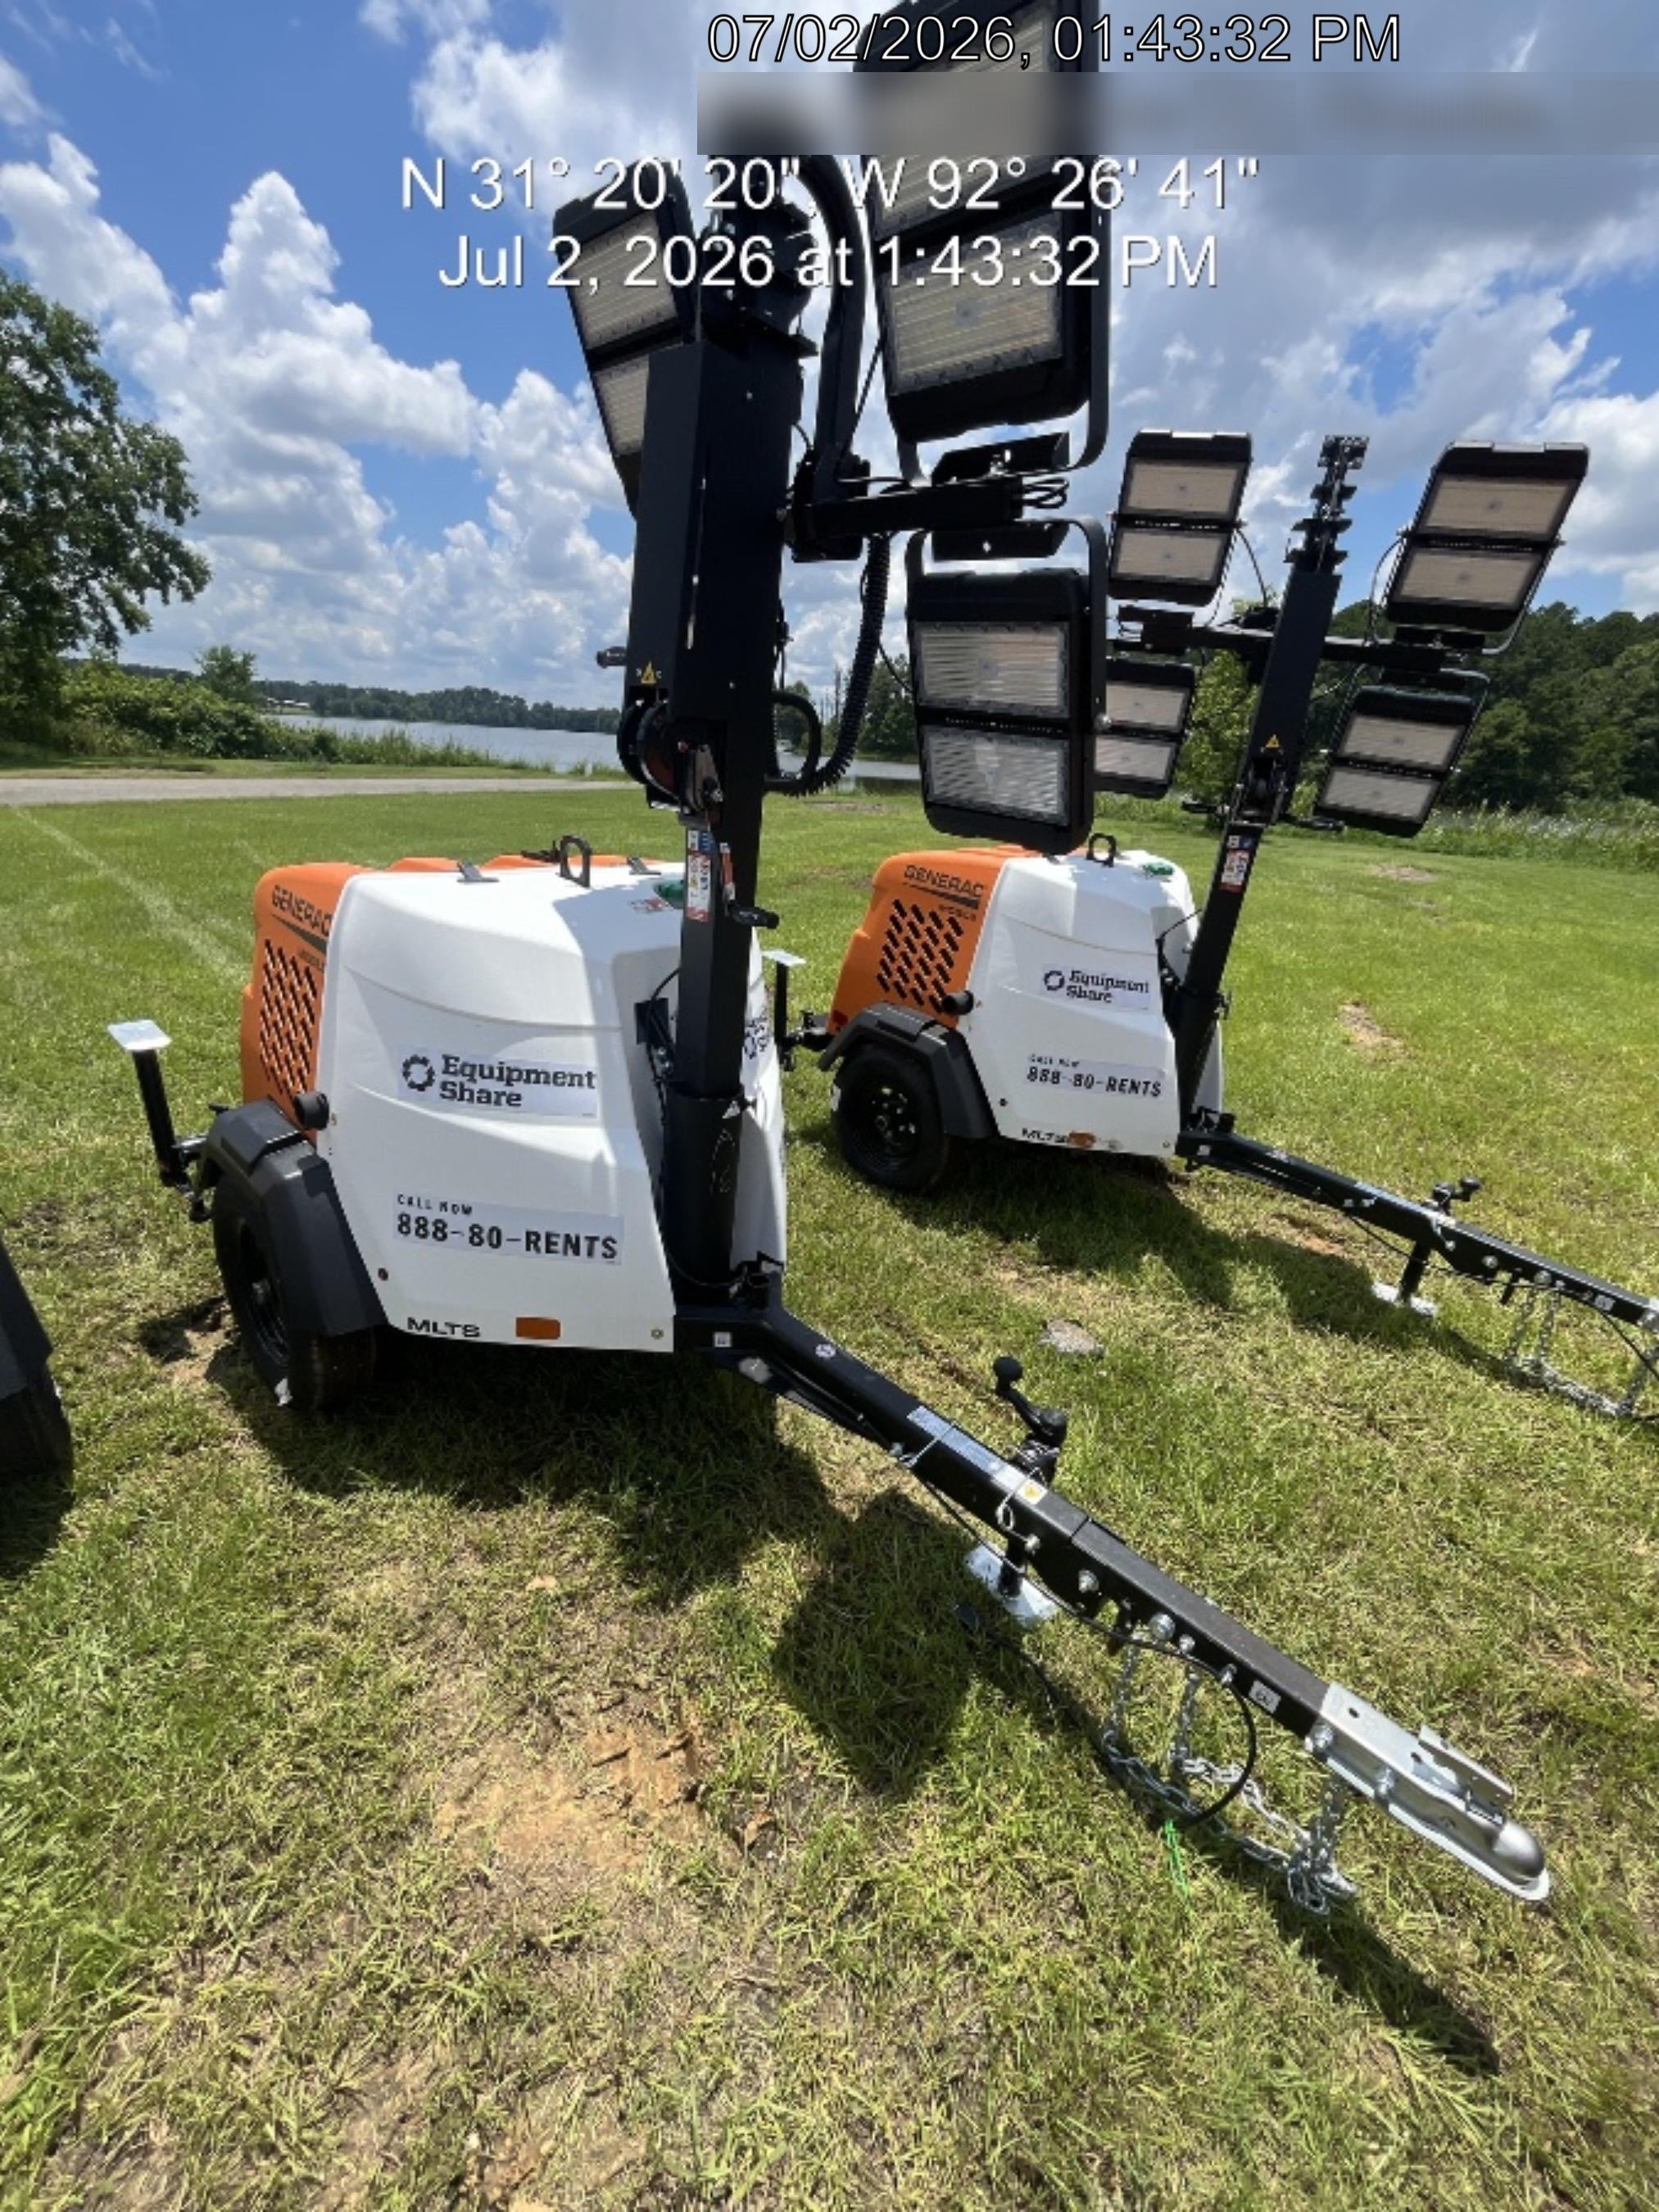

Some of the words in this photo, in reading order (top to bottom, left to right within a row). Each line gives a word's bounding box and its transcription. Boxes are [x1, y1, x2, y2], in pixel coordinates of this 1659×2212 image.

[904, 865, 984, 897] GENERAC
[1066, 985, 1113, 1003] Share
[1068, 969, 1149, 994] Equipment
[441, 1054, 597, 1089] Equipment
[1027, 1066, 1163, 1098] 888-80-RENTS
[439, 1080, 523, 1107] Share
[397, 1193, 433, 1209] CALL
[439, 1199, 473, 1216] NOW
[397, 1212, 619, 1260] 888-80-RENTS
